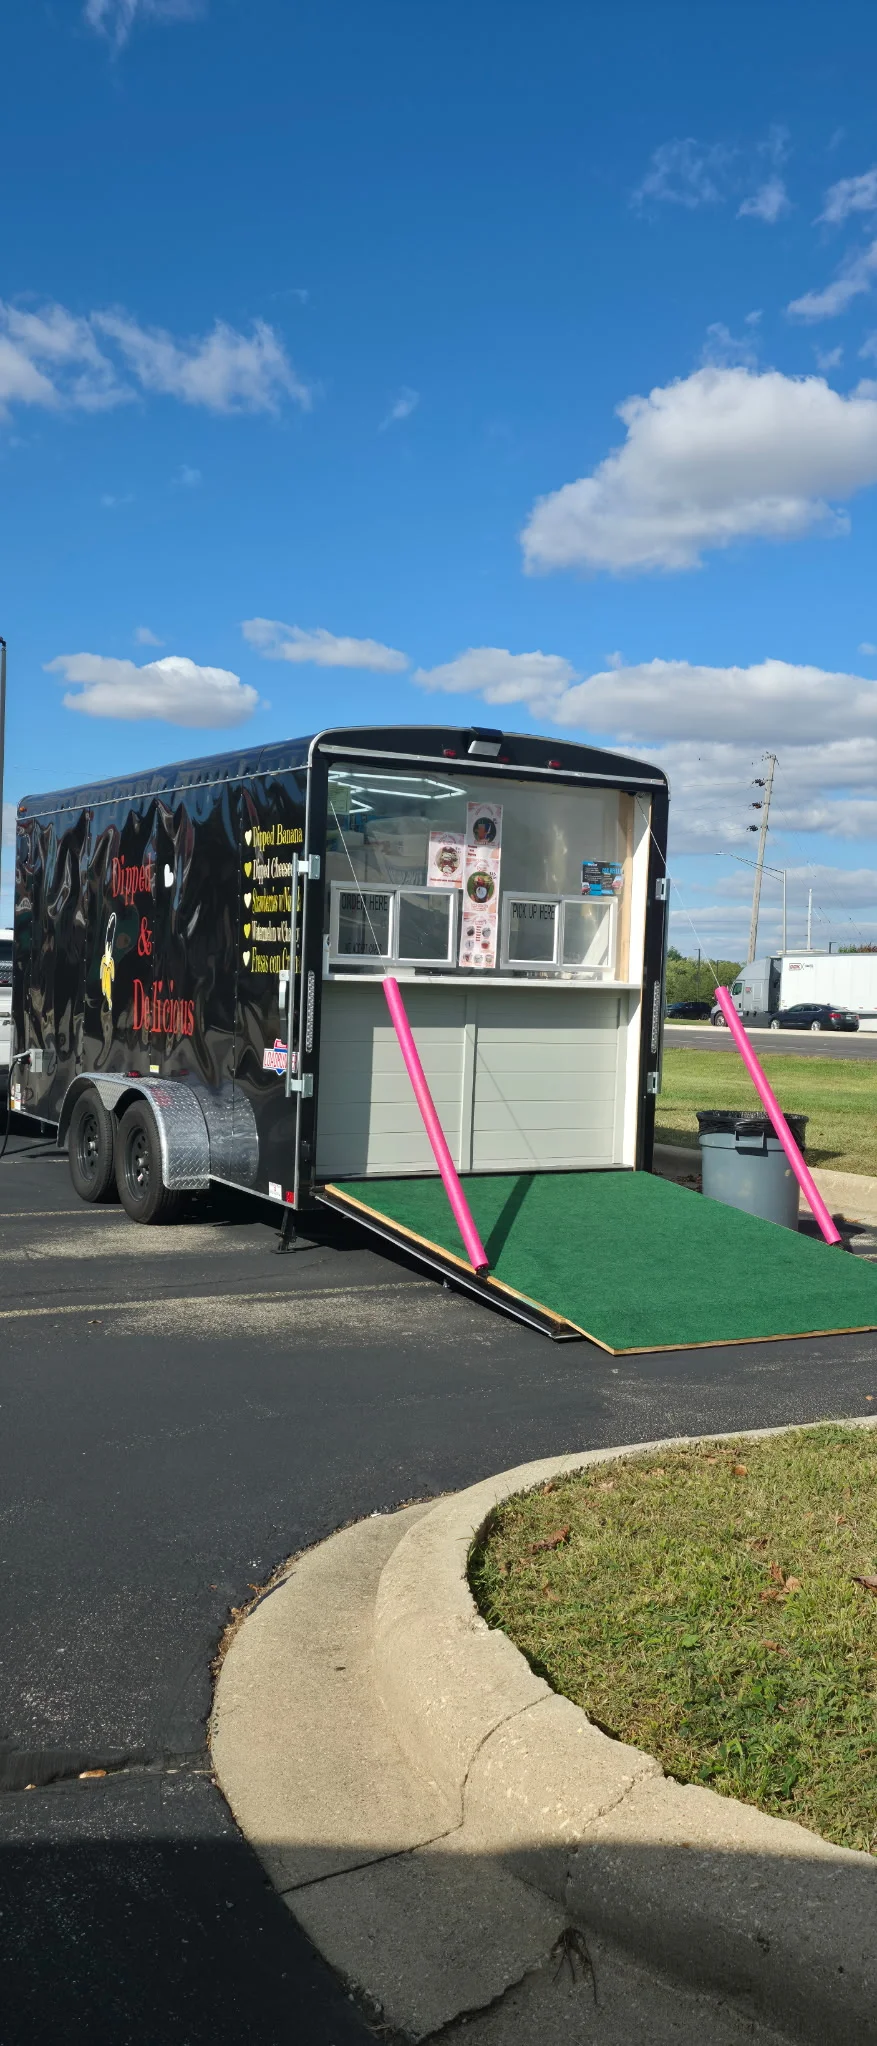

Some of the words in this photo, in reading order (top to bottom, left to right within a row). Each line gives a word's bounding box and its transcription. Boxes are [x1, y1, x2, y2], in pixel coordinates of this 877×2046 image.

[252, 825, 275, 852] Dipped
[276, 823, 303, 846] Banana
[112, 853, 152, 906] Dipped
[253, 858, 270, 885] Dipped
[341, 893, 367, 911] ORDER
[369, 894, 388, 912] HERE
[512, 902, 527, 919] PICK
[528, 904, 537, 919] UP
[539, 904, 555, 920] HERE
[137, 916, 152, 956] &
[251, 946, 269, 973] Fresas
[269, 954, 281, 973] con
[132, 979, 195, 1036] Delicious
